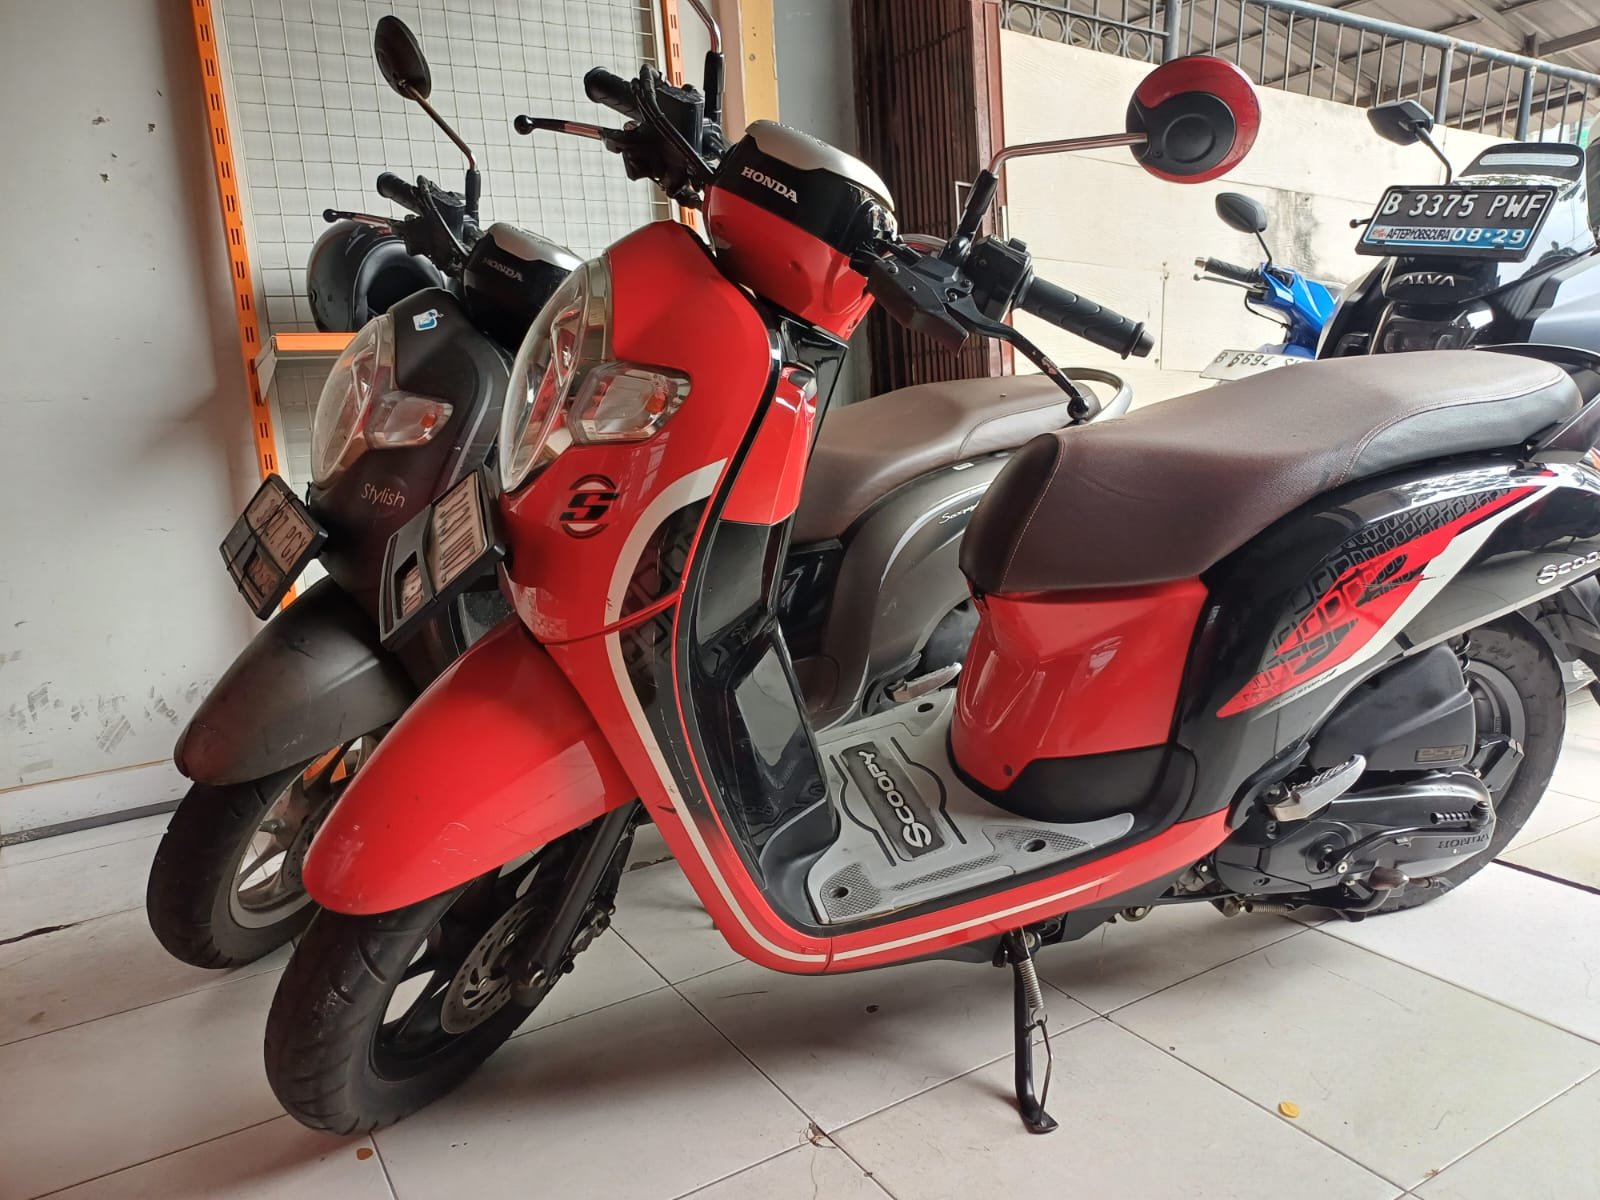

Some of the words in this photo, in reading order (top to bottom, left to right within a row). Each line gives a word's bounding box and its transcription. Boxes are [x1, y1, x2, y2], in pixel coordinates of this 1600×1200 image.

[740, 166, 799, 203] HONDA
[1381, 193, 1403, 216] B
[1408, 194, 1478, 218] 3375
[1486, 194, 1546, 218] PWF
[482, 257, 523, 281] HONDA
[1214, 352, 1228, 364] B
[361, 483, 405, 508] Stylish
